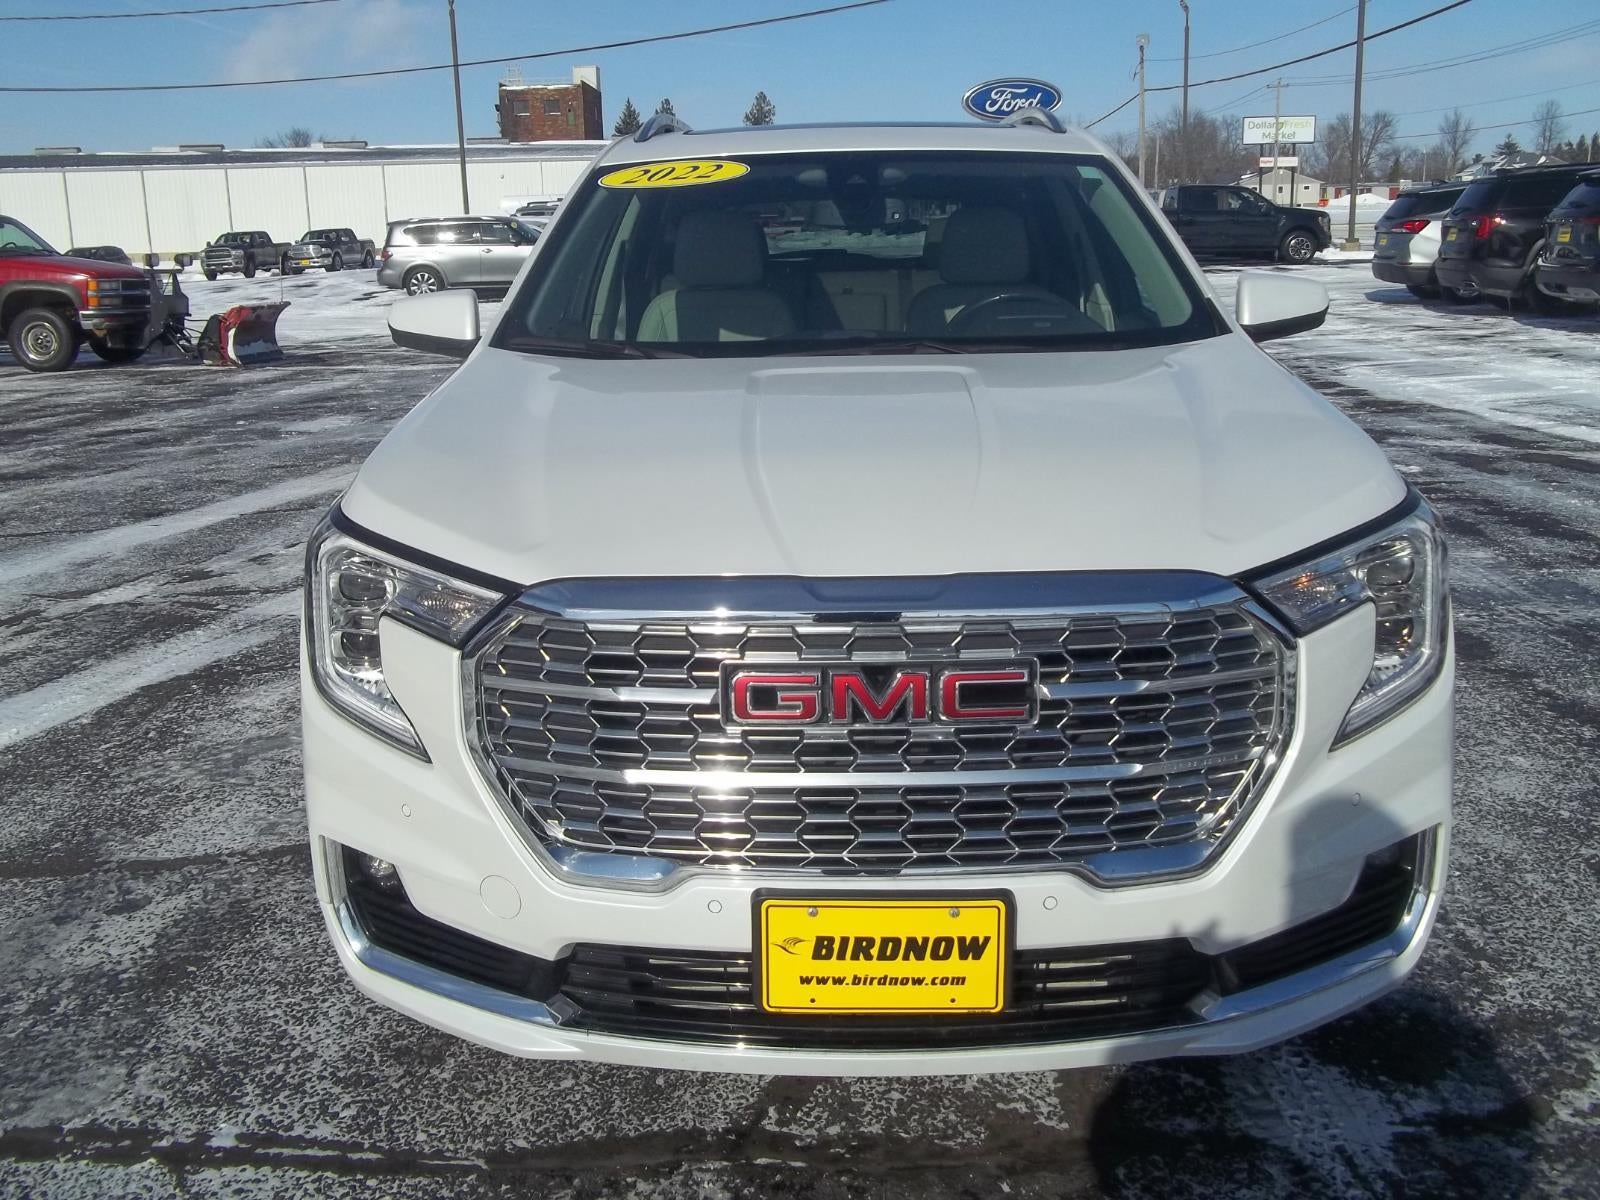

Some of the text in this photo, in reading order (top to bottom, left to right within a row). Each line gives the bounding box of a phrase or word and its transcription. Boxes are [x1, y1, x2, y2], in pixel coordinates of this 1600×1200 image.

[985, 87, 1043, 112] Ford
[1284, 120, 1311, 129] Fresh
[620, 163, 724, 185] 2022
[731, 669, 1029, 724] GMC
[811, 935, 991, 961] BIRDNOW
[799, 974, 966, 986] www.birdnow.com
